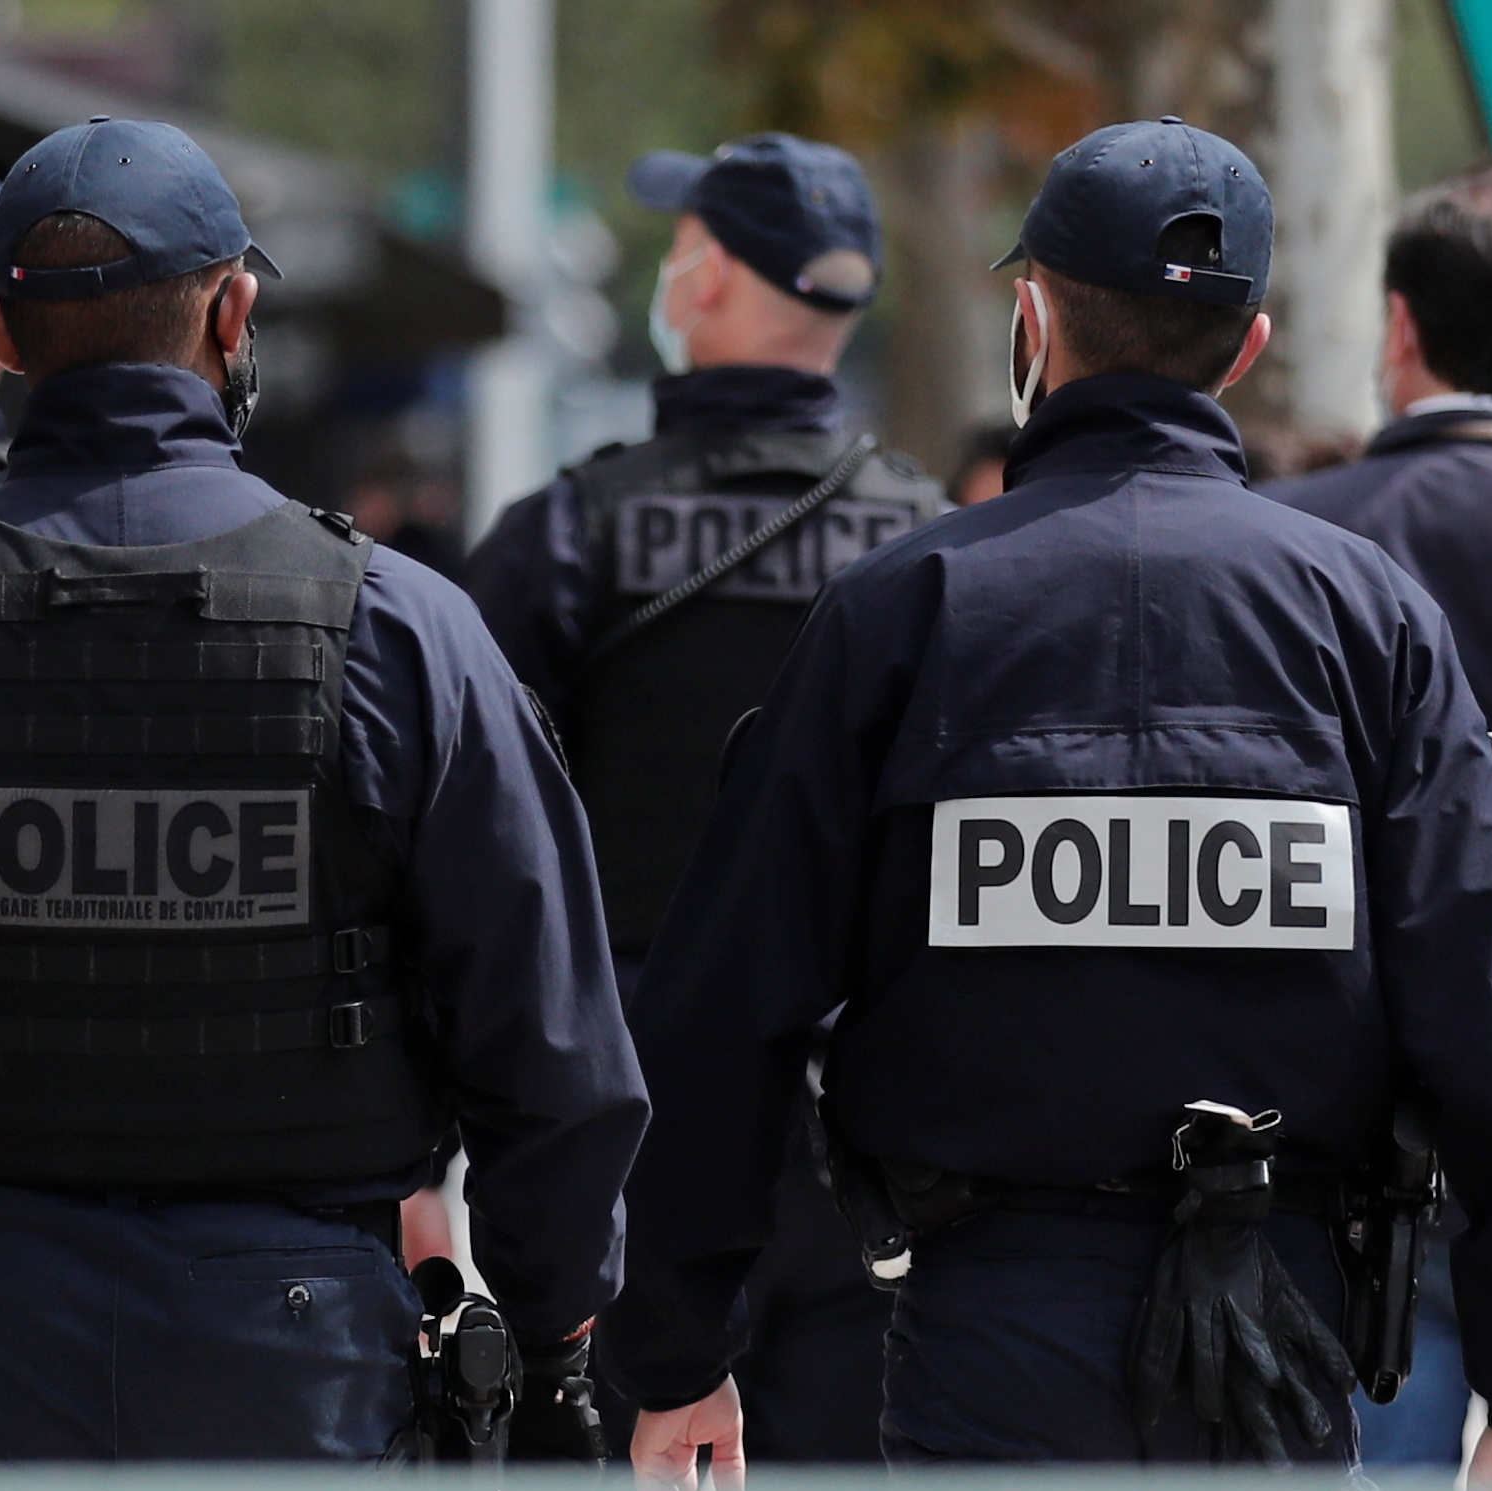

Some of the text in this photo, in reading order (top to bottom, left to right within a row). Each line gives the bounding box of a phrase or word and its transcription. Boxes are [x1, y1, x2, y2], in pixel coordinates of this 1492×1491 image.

[958, 818, 1328, 928] POLICE
[46, 897, 152, 920] TERRITORIALE
[159, 900, 178, 920] DE
[184, 899, 255, 921] CONTACT
